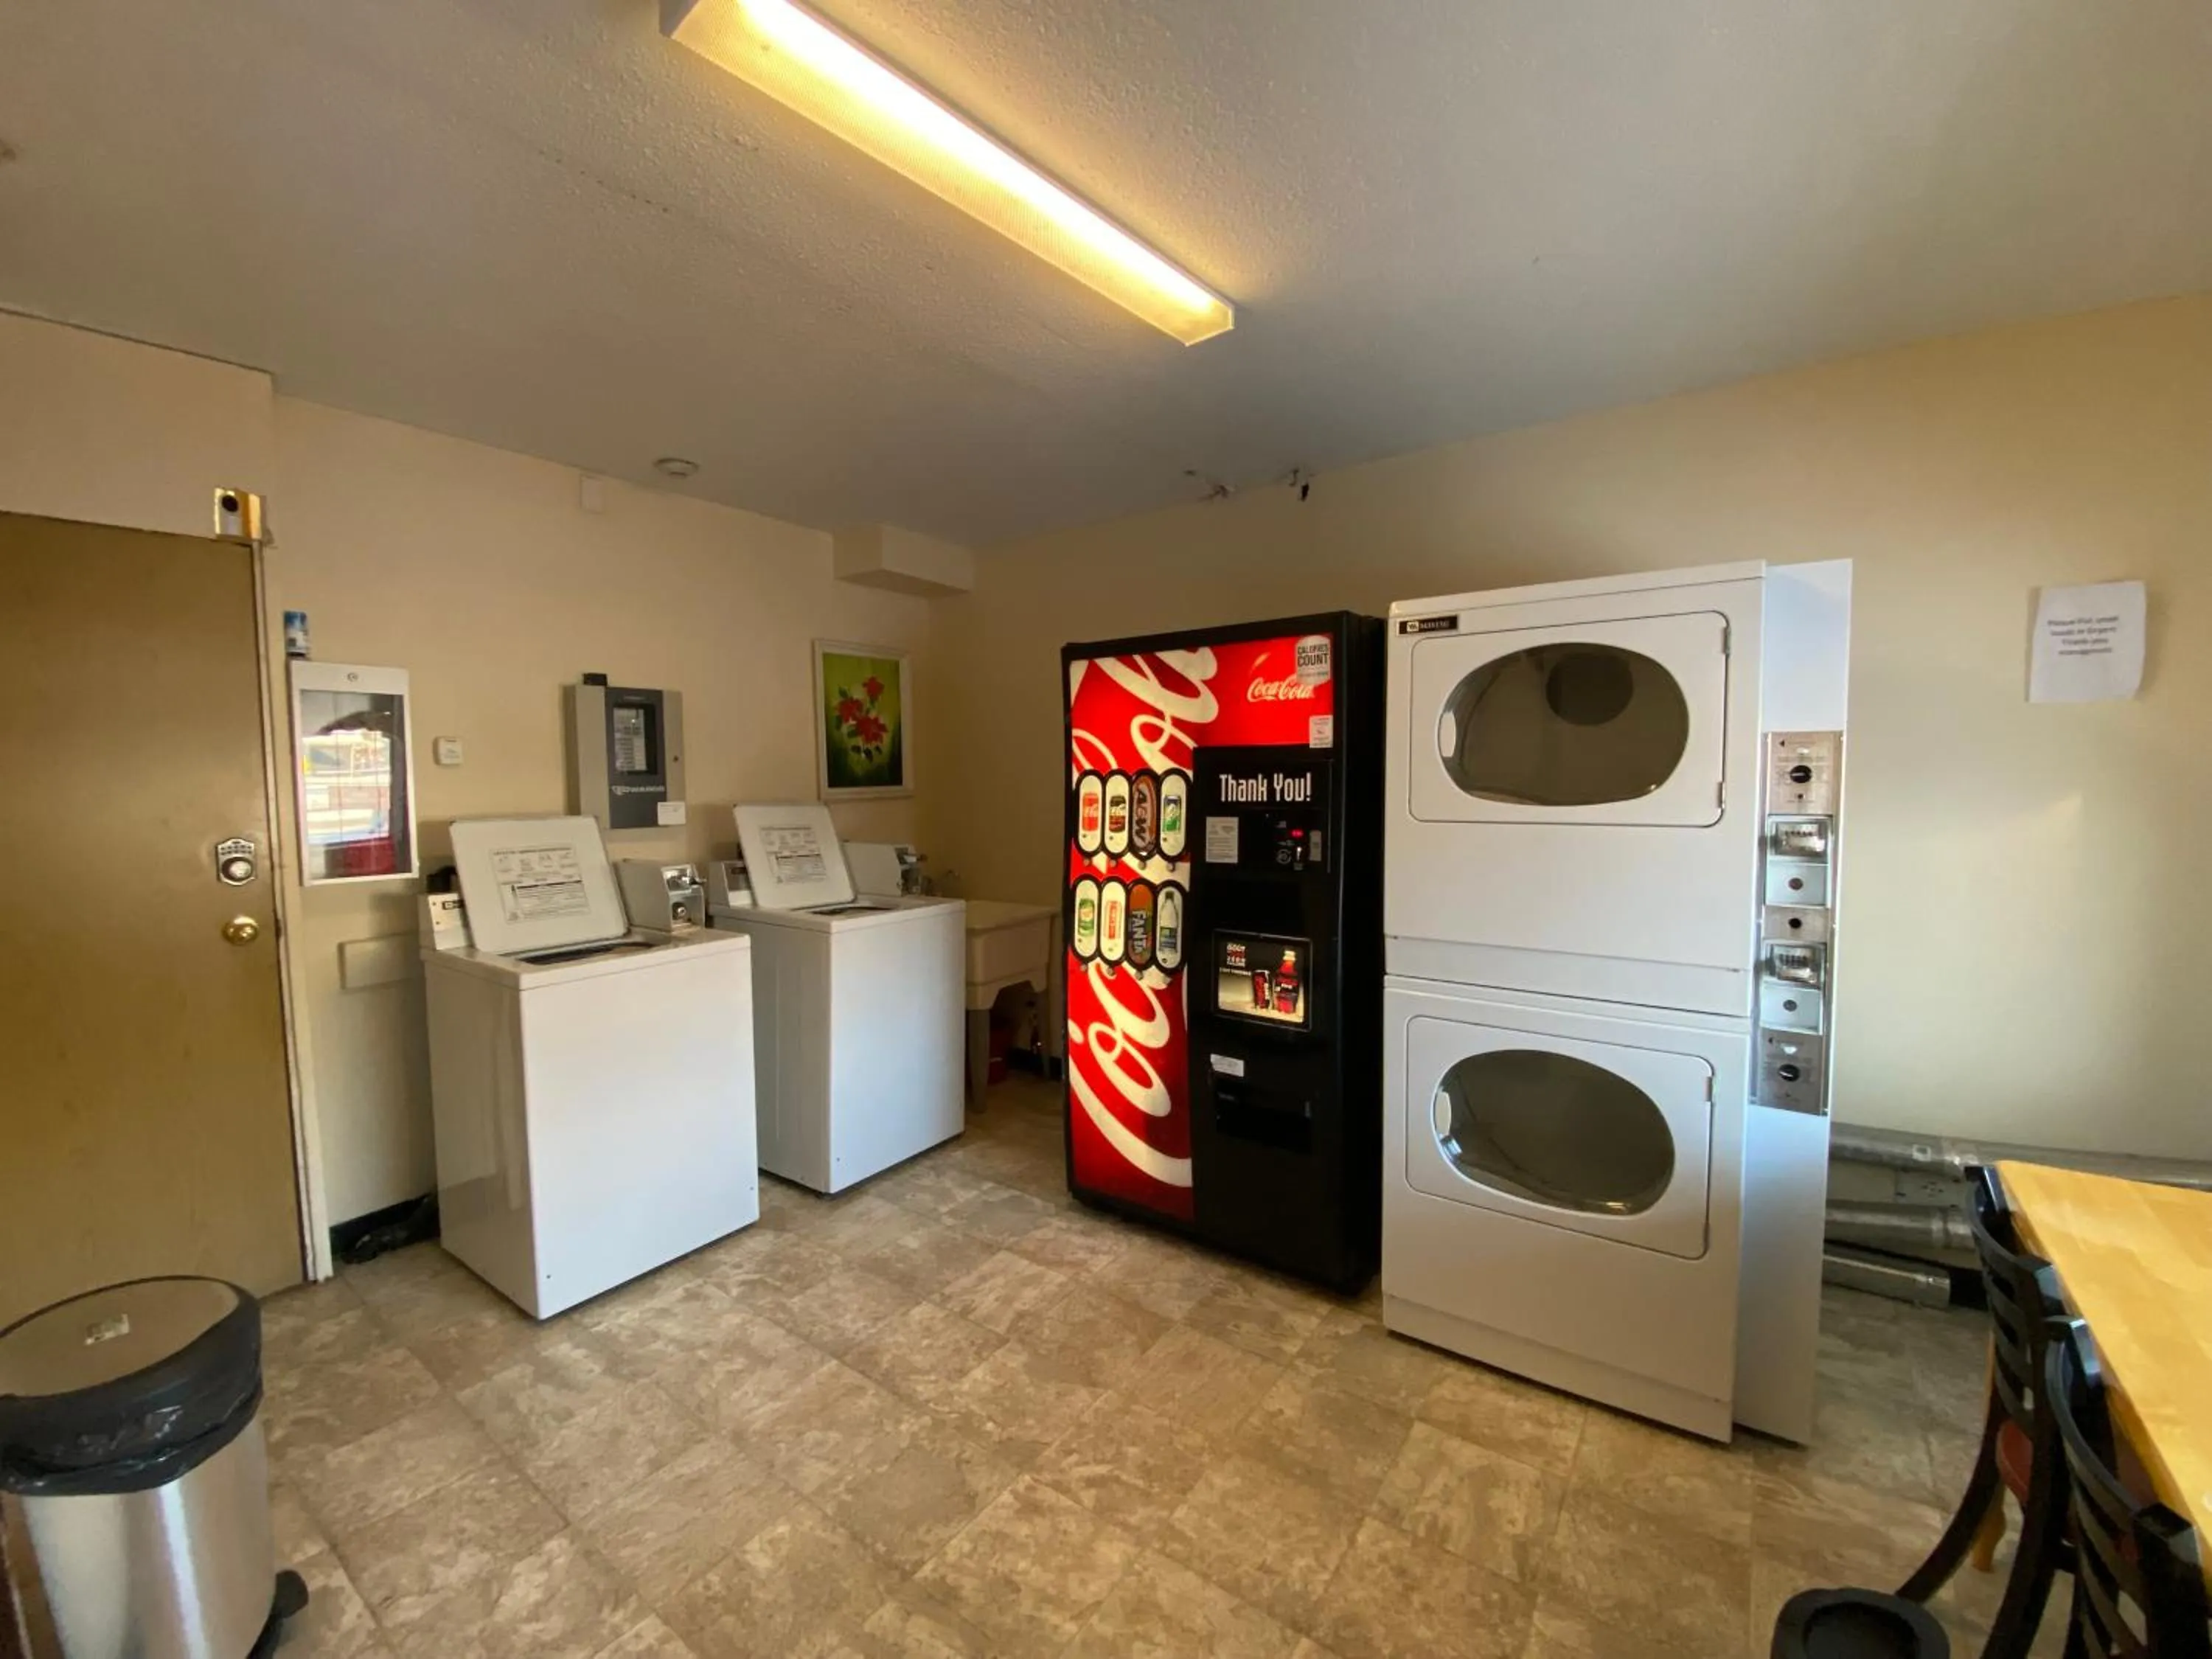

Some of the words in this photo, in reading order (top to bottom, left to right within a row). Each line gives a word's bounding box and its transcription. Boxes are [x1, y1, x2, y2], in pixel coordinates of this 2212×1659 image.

[1297, 653, 1329, 667] COUNT
[1219, 773, 1267, 802] Thank
[1273, 772, 1312, 801] You!
